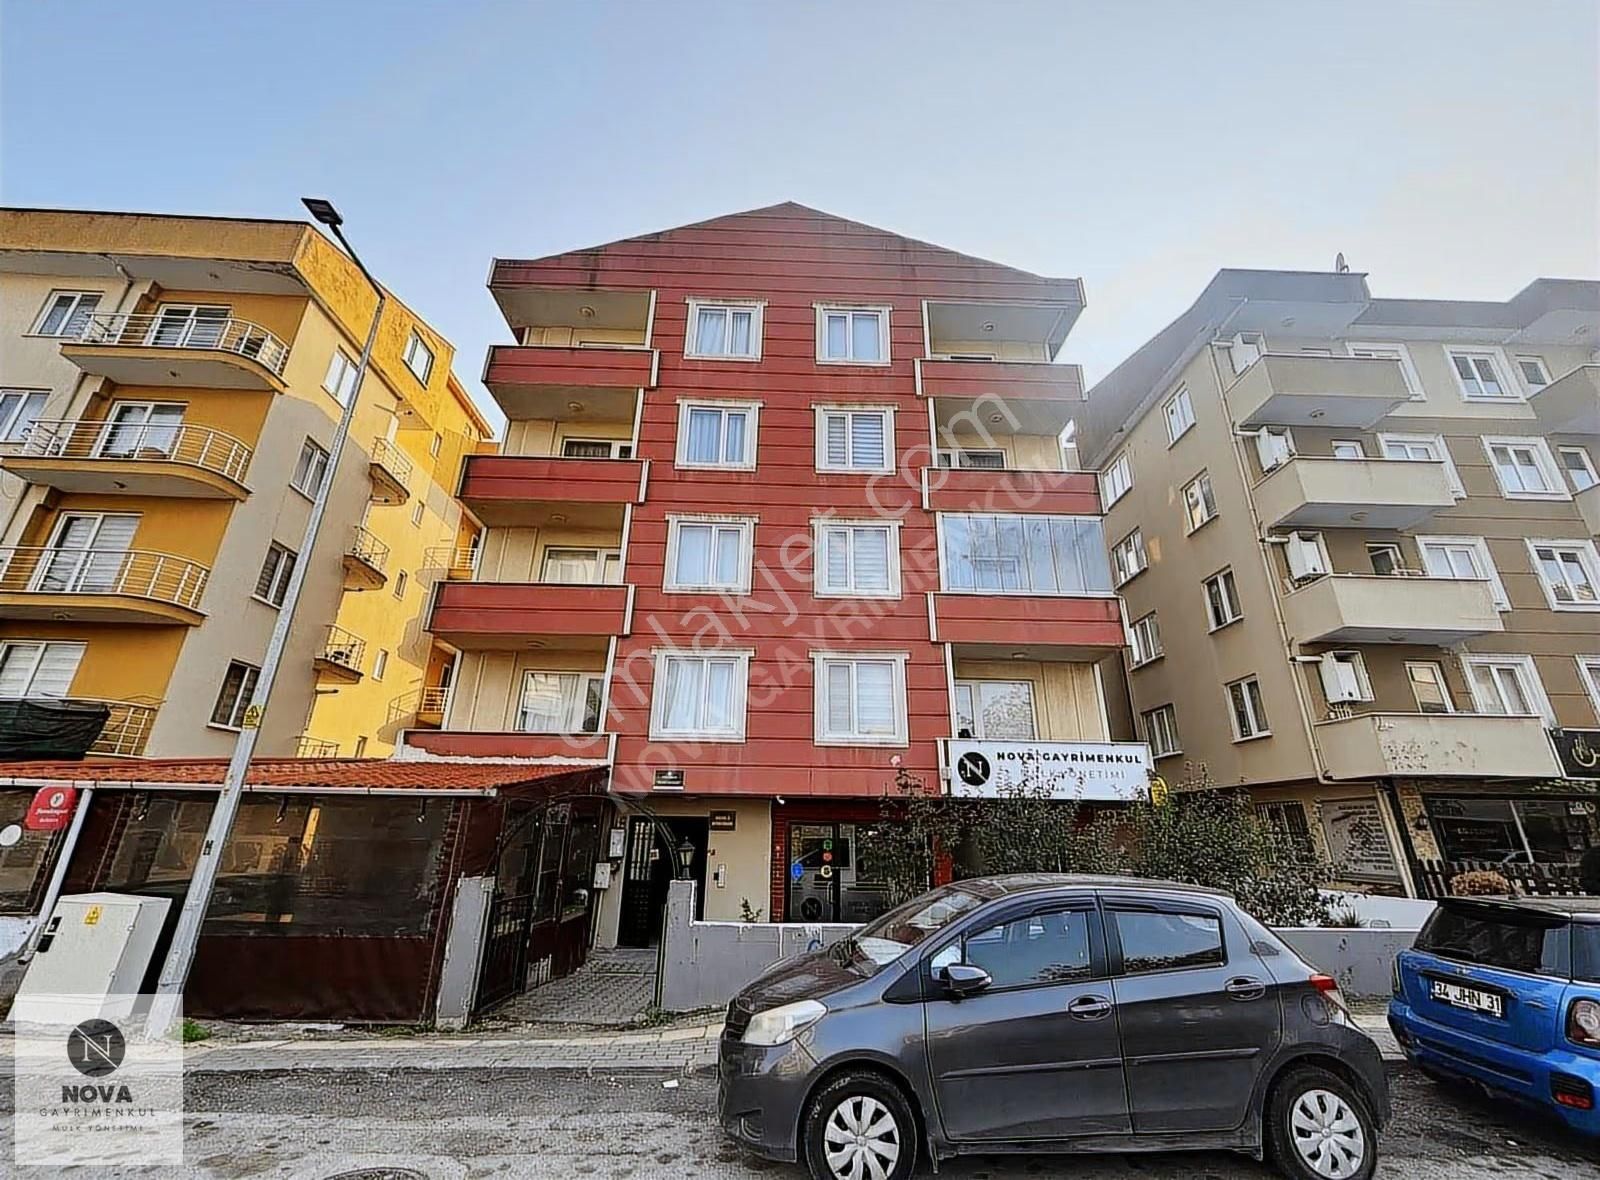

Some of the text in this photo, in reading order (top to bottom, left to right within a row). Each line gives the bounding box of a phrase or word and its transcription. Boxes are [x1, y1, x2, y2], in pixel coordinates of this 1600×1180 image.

[996, 751, 1142, 764] NOVA GAYRİMENKUL
[1436, 982, 1500, 1012] 34 JHN 31
